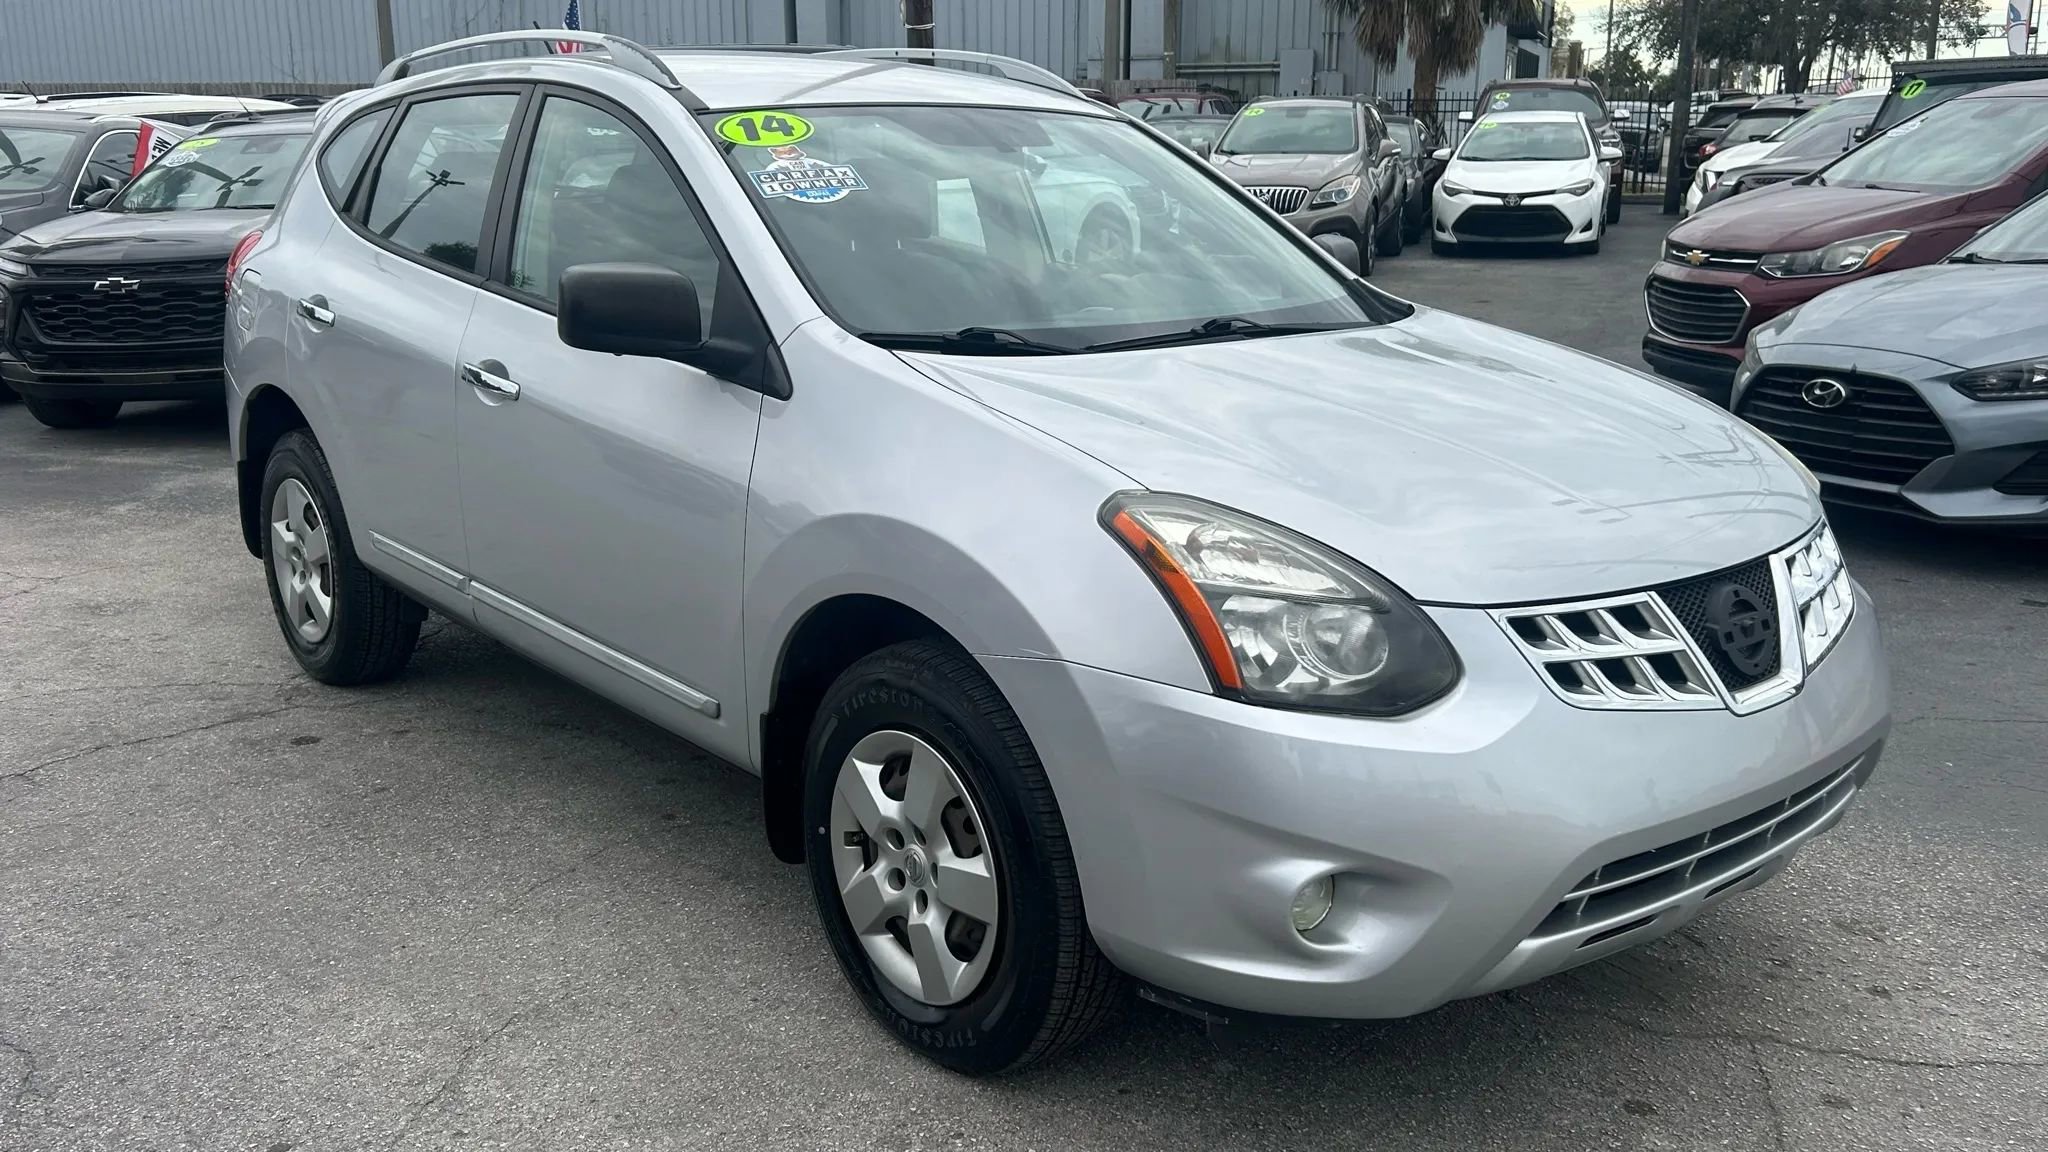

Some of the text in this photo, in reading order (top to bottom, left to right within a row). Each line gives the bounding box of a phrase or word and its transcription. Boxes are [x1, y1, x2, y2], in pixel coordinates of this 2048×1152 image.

[1904, 82, 1923, 96] 17
[736, 115, 795, 141] 14
[760, 169, 850, 182] CARFAX
[766, 178, 858, 193] 1 OWNER
